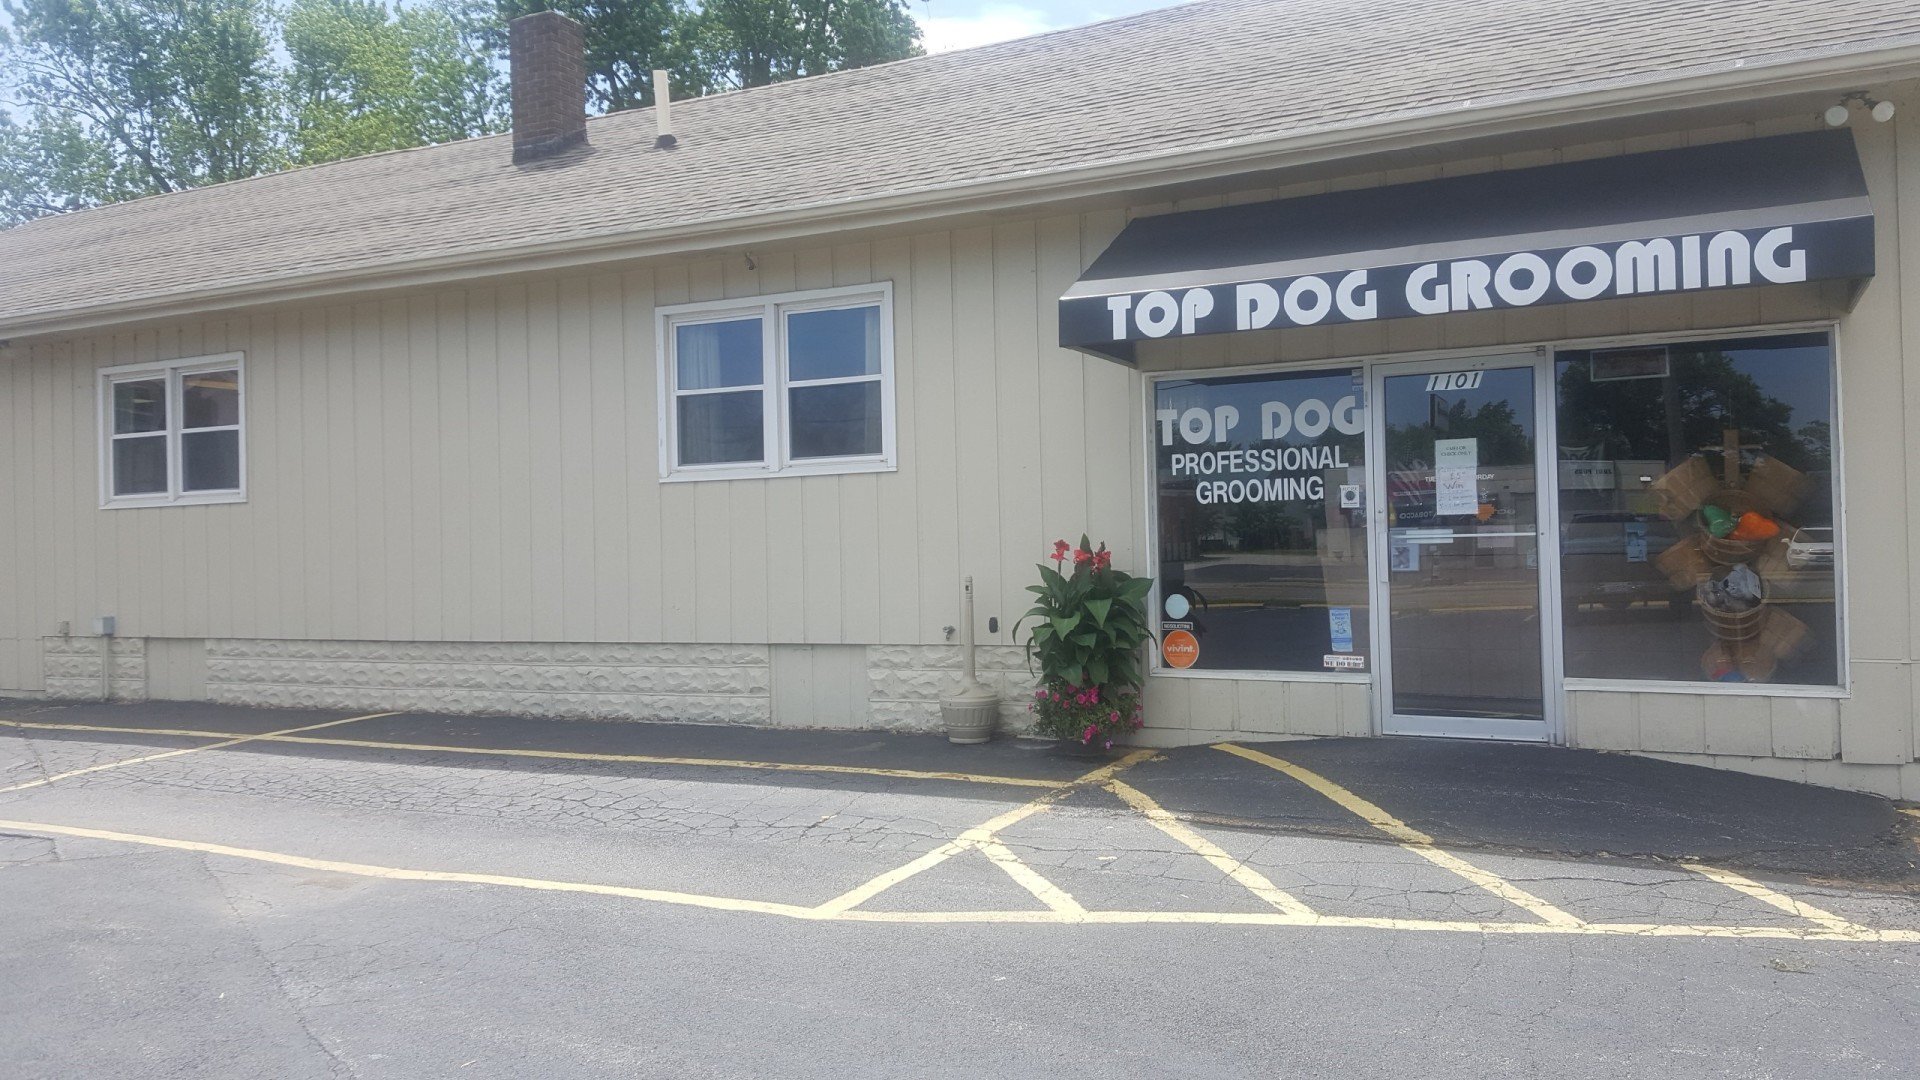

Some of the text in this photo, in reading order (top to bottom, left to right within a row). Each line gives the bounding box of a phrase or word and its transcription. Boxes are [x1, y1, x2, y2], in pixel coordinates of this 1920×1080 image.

[1107, 226, 1808, 341] TOP DOG GROOMING
[1431, 372, 1479, 391] 1101
[1156, 395, 1365, 446] TOP DOG
[1171, 445, 1349, 476] PROFESSIONAL
[1196, 476, 1324, 505] GROOMING
